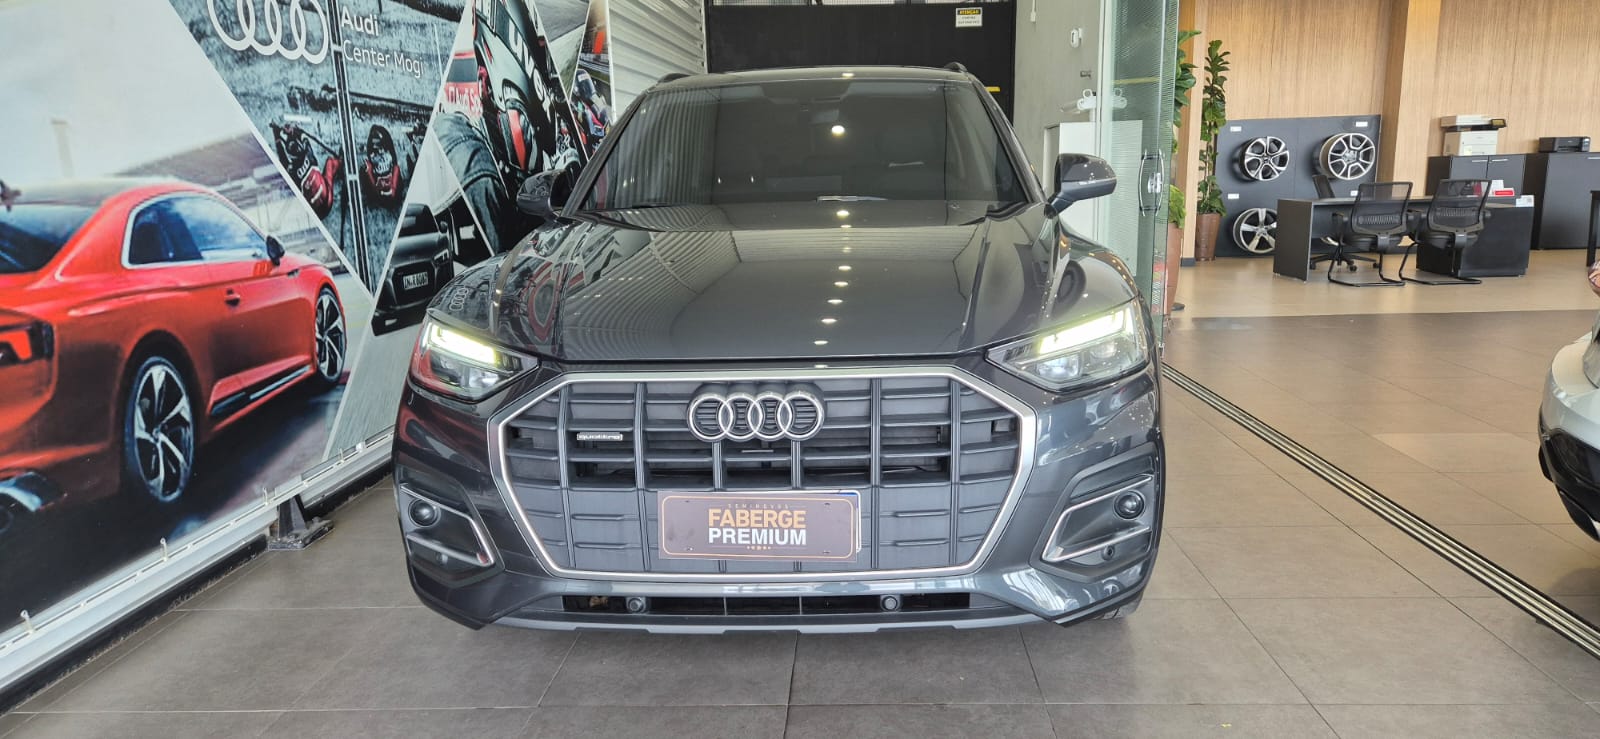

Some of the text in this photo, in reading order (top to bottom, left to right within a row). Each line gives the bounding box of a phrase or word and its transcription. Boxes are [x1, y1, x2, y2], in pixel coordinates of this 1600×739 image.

[341, 5, 379, 36] Audi
[343, 39, 424, 79] Center Mogi
[708, 508, 807, 528] FABERGE
[708, 527, 807, 545] PREMIUM
